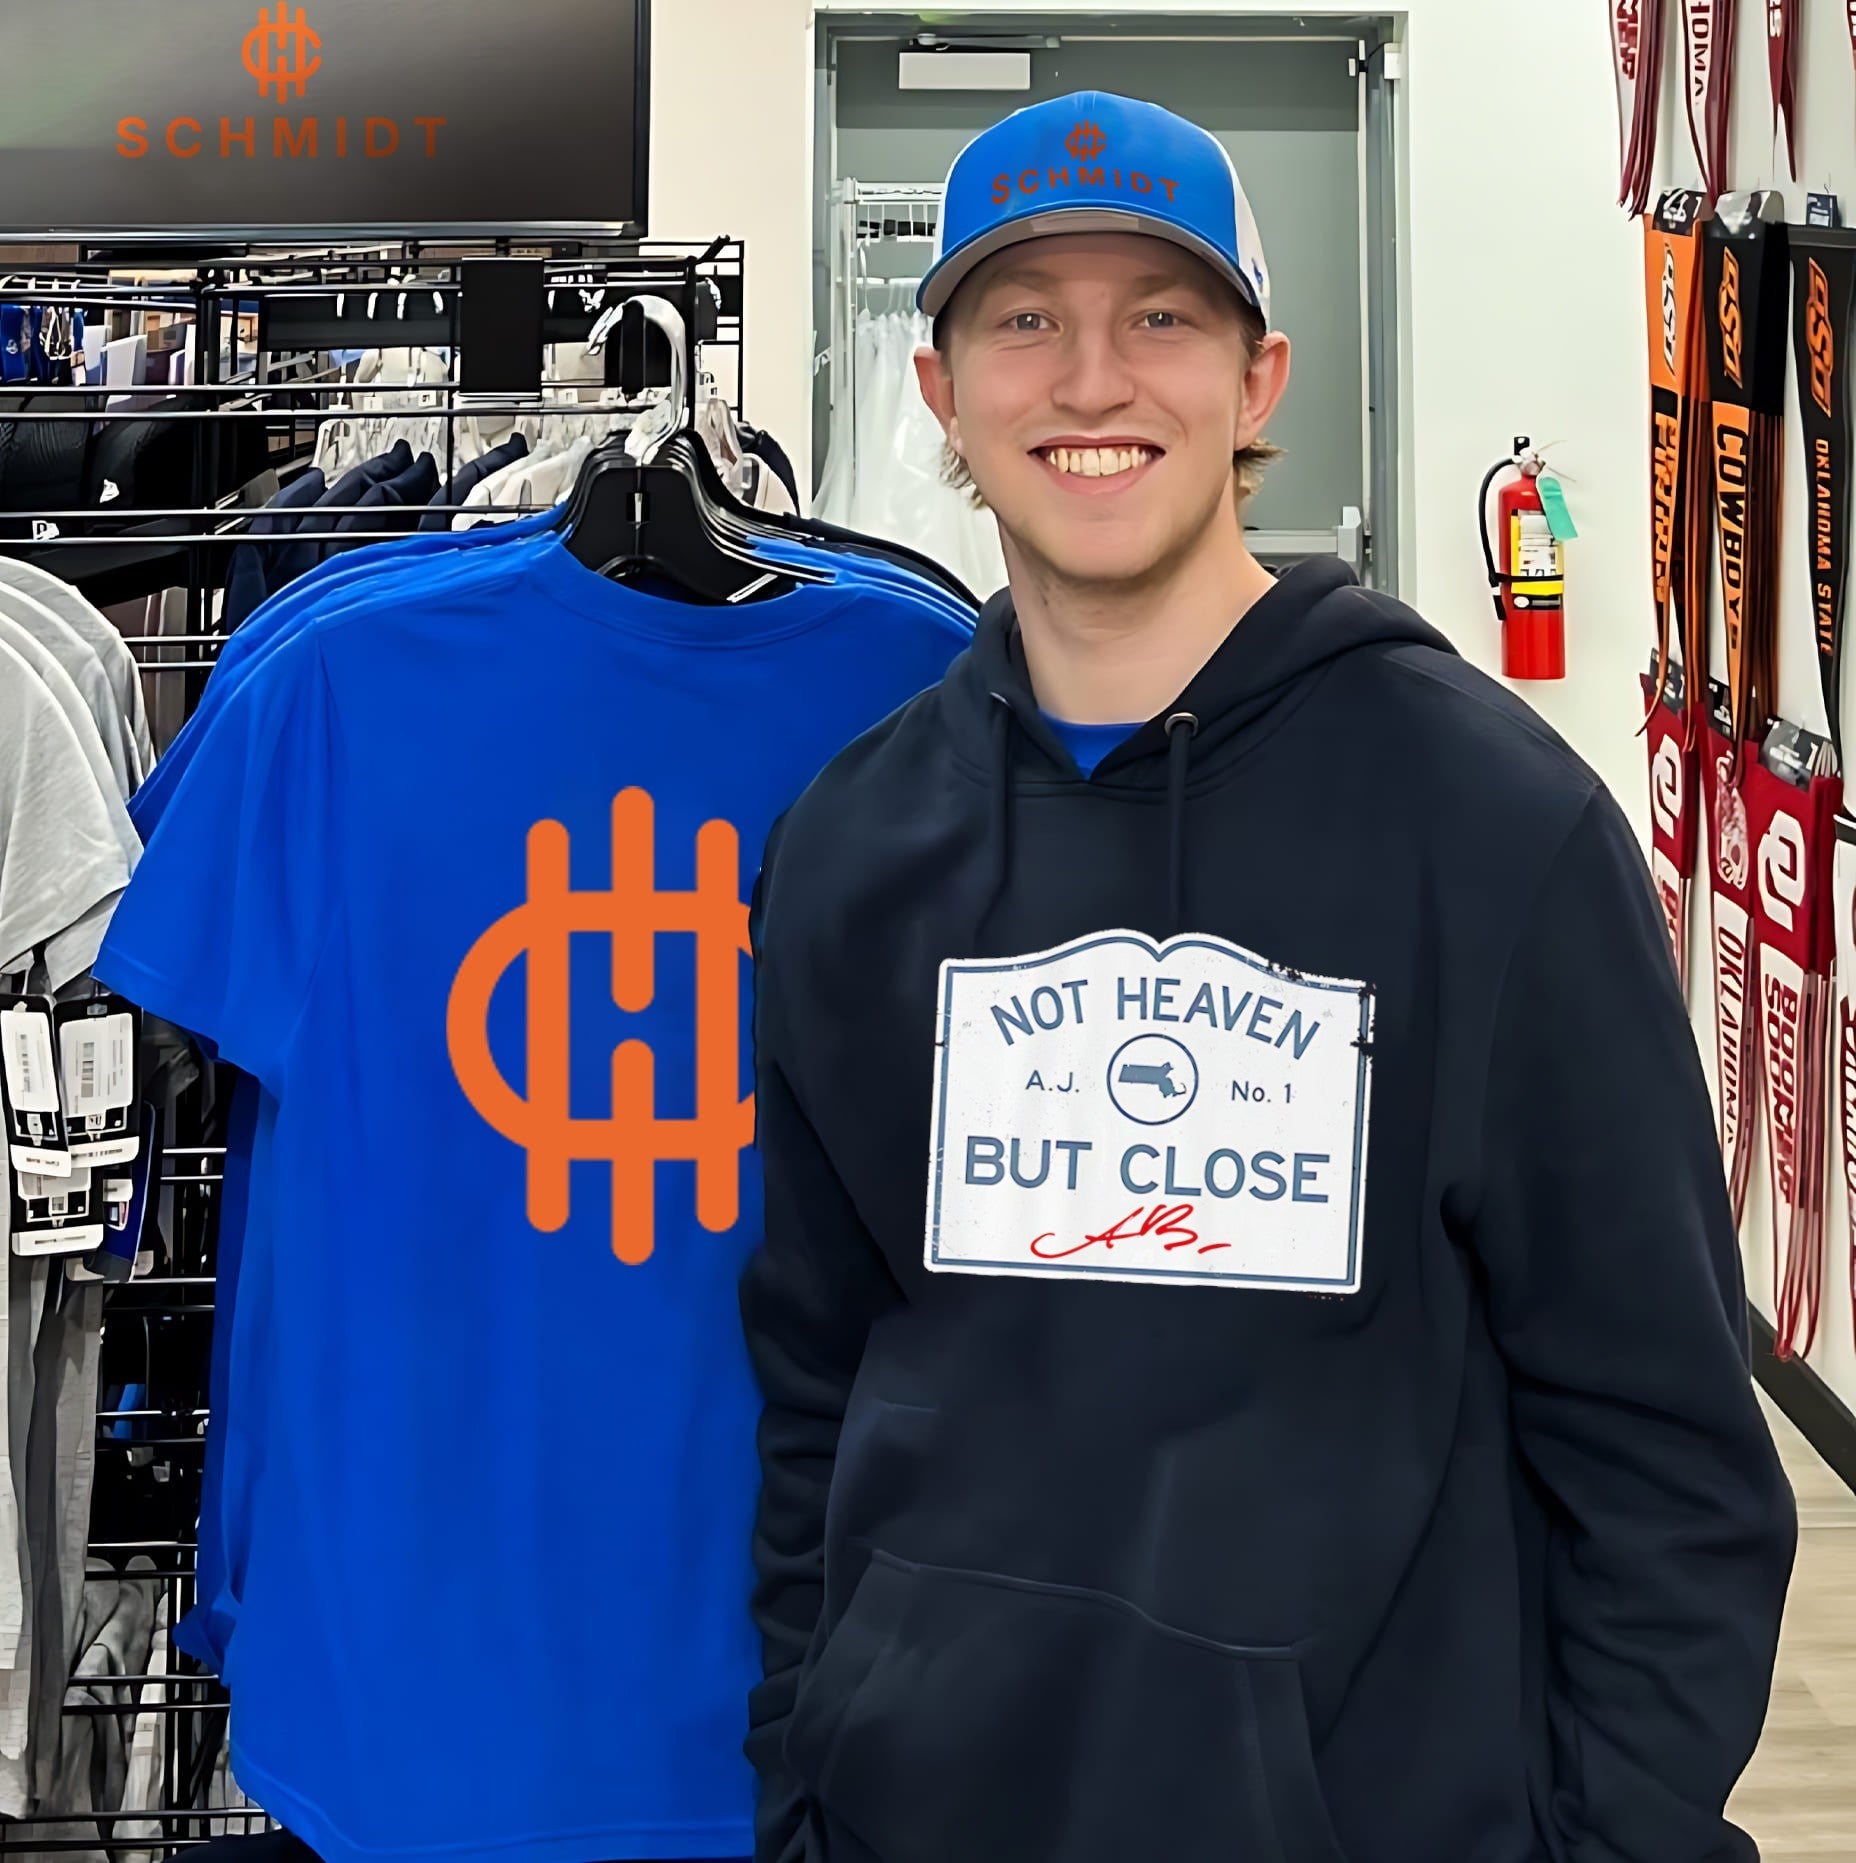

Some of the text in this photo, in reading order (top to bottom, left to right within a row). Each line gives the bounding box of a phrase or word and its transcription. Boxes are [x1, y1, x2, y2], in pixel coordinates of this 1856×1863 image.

[116, 116, 447, 159] SCHMIDT
[991, 167, 1179, 204] SCHMIDT
[1717, 423, 1749, 650] COWBOY
[1815, 438, 1832, 570] OKLAHOMA
[990, 976, 1320, 1060] NOT HEAVEN
[1718, 926, 1745, 1144] OKLAHOMA
[1025, 1070, 1080, 1093] A.J.
[1231, 1081, 1293, 1104] No. 1
[964, 1135, 1331, 1204] BUT CLOSE
